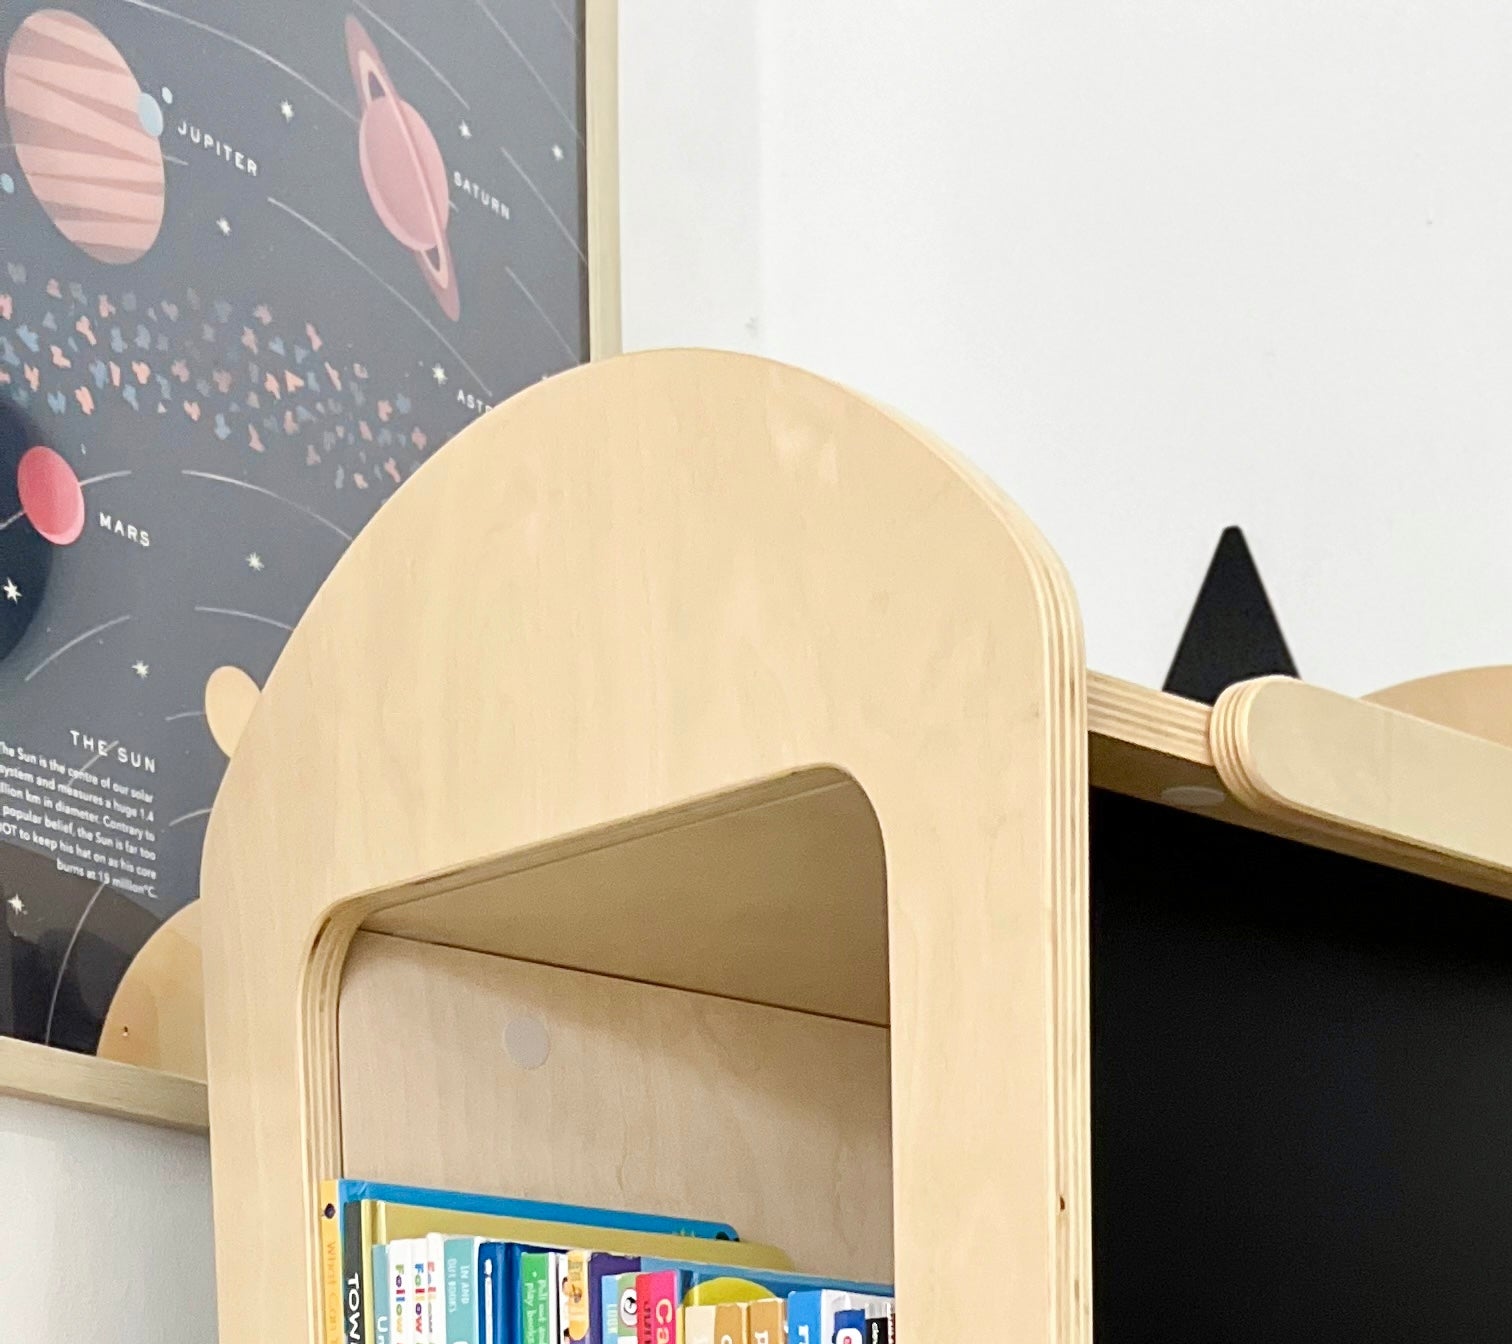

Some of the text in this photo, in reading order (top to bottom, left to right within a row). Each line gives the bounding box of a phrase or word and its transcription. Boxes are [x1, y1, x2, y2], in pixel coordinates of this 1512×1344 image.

[178, 121, 258, 177] JUPITER
[453, 171, 510, 220] SATURN
[99, 513, 150, 548] MARS
[69, 730, 156, 773] THE SUN
[395, 1264, 406, 1334] Follow
[414, 1263, 425, 1334] Follow
